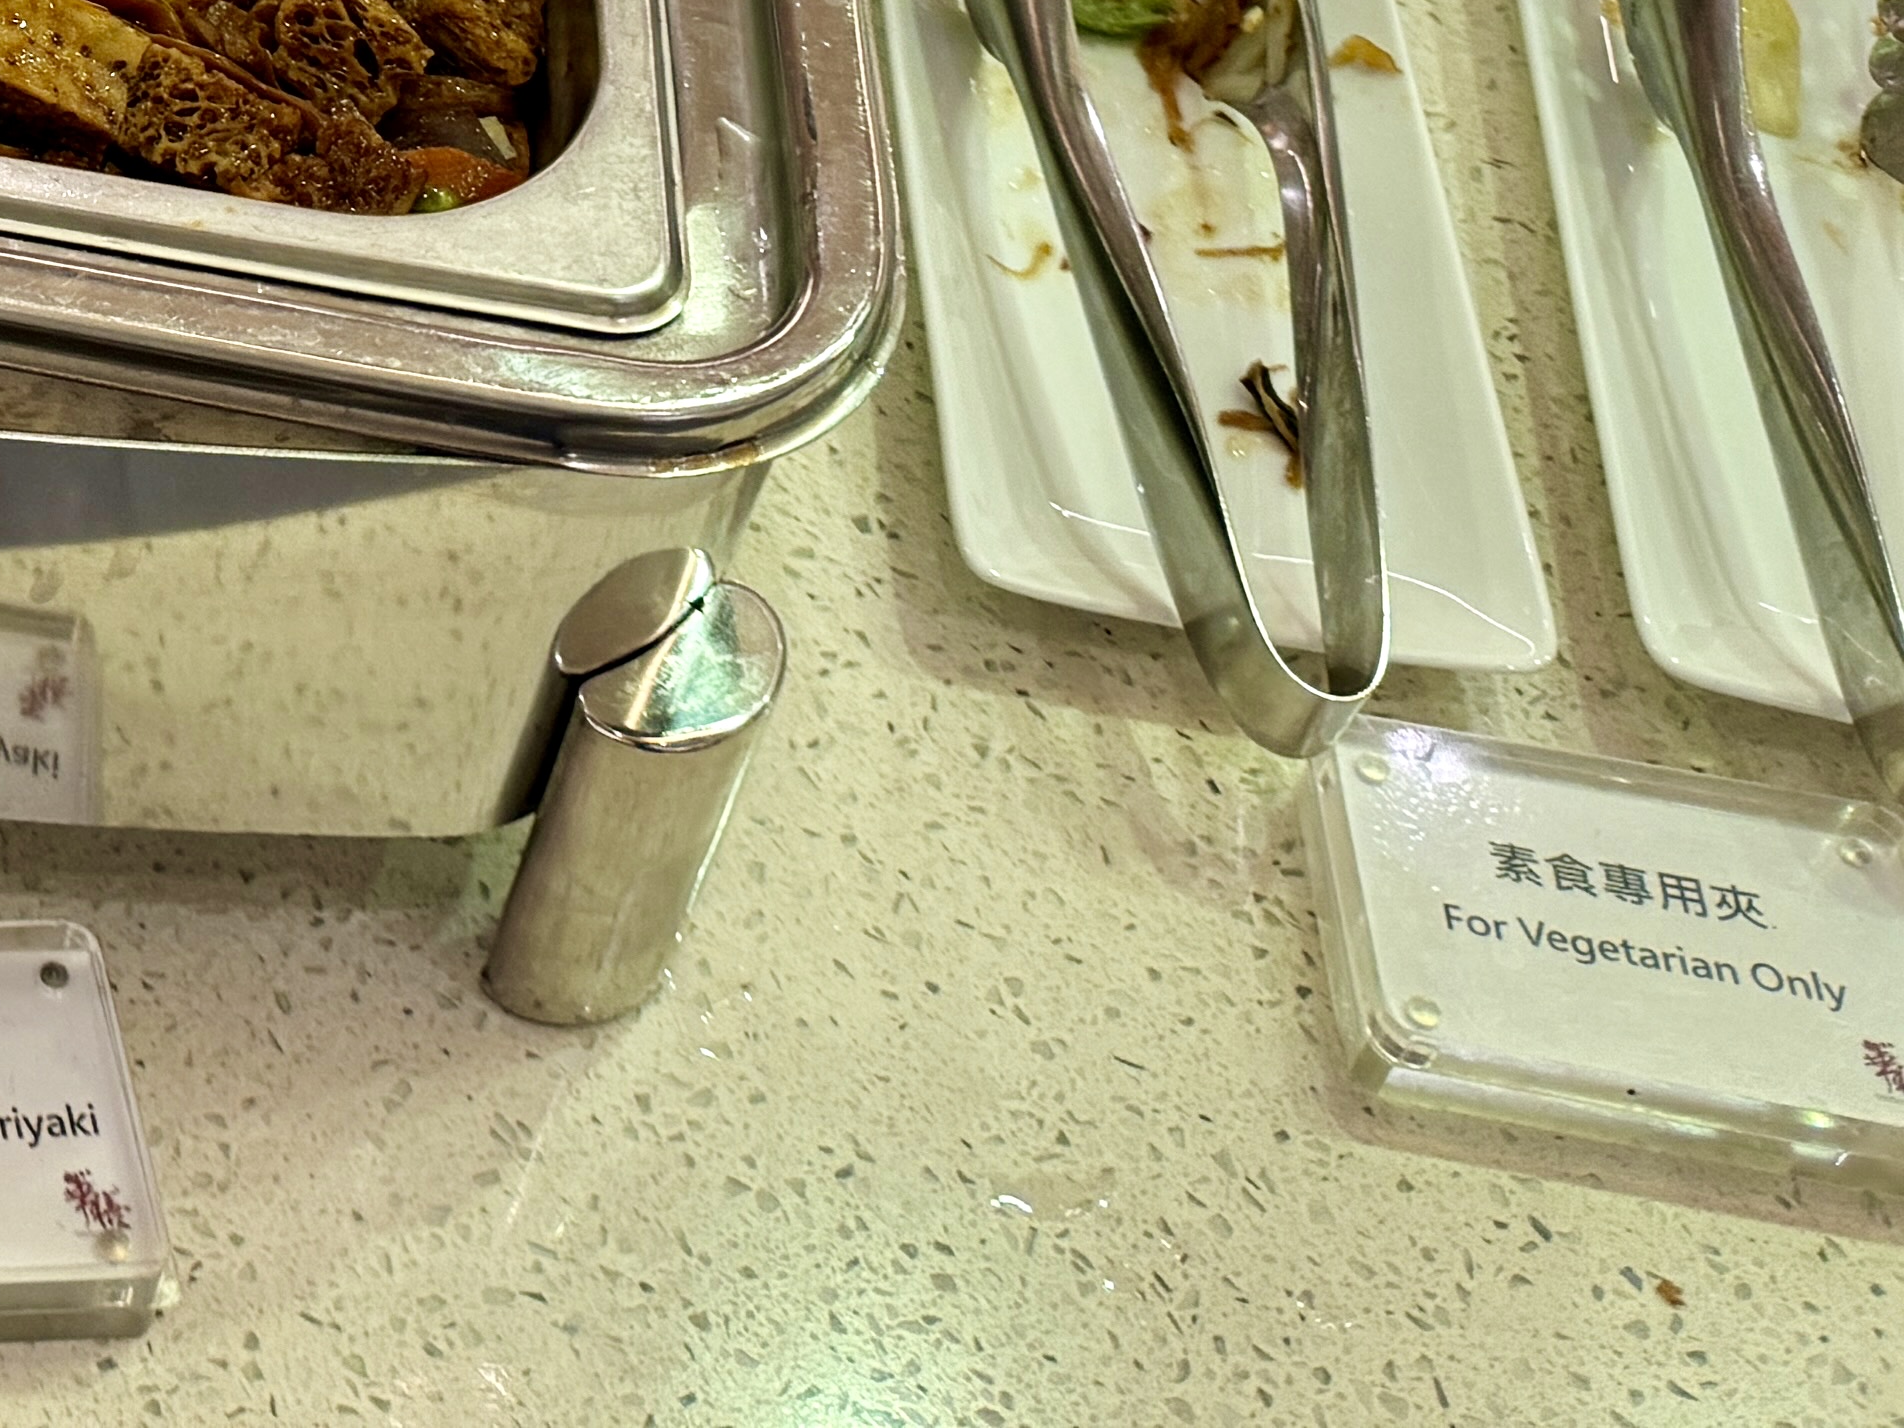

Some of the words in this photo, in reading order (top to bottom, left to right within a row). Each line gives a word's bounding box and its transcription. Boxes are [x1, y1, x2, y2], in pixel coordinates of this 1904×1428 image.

[1488, 840, 1770, 931] 素食專用夾
[1442, 902, 1508, 941] For
[1515, 915, 1741, 986] Vegetarian
[1749, 961, 1847, 1013] Only
